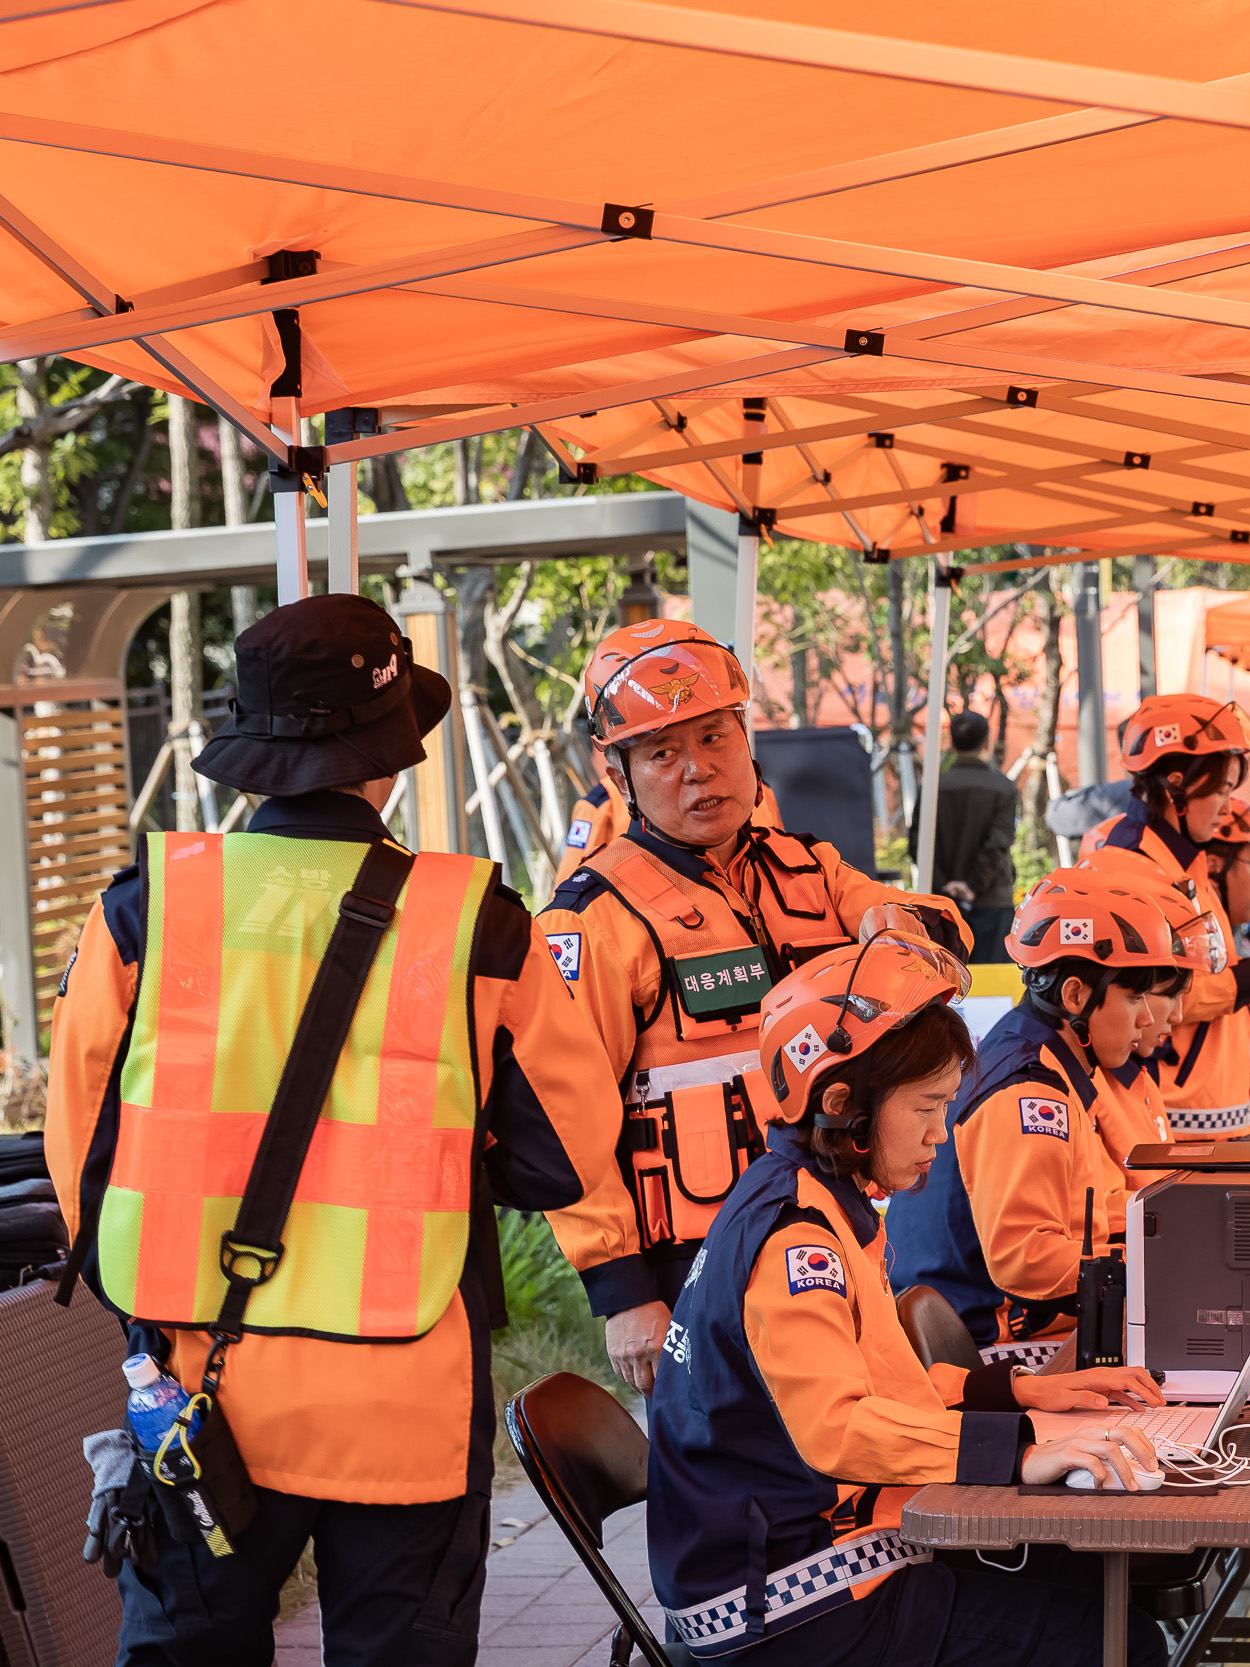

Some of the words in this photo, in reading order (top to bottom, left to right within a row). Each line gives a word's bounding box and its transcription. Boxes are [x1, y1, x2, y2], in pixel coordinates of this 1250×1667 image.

[684, 962, 766, 993] 대응계획부
[1028, 1125, 1066, 1139] KOREA
[796, 1277, 842, 1291] KOREA
